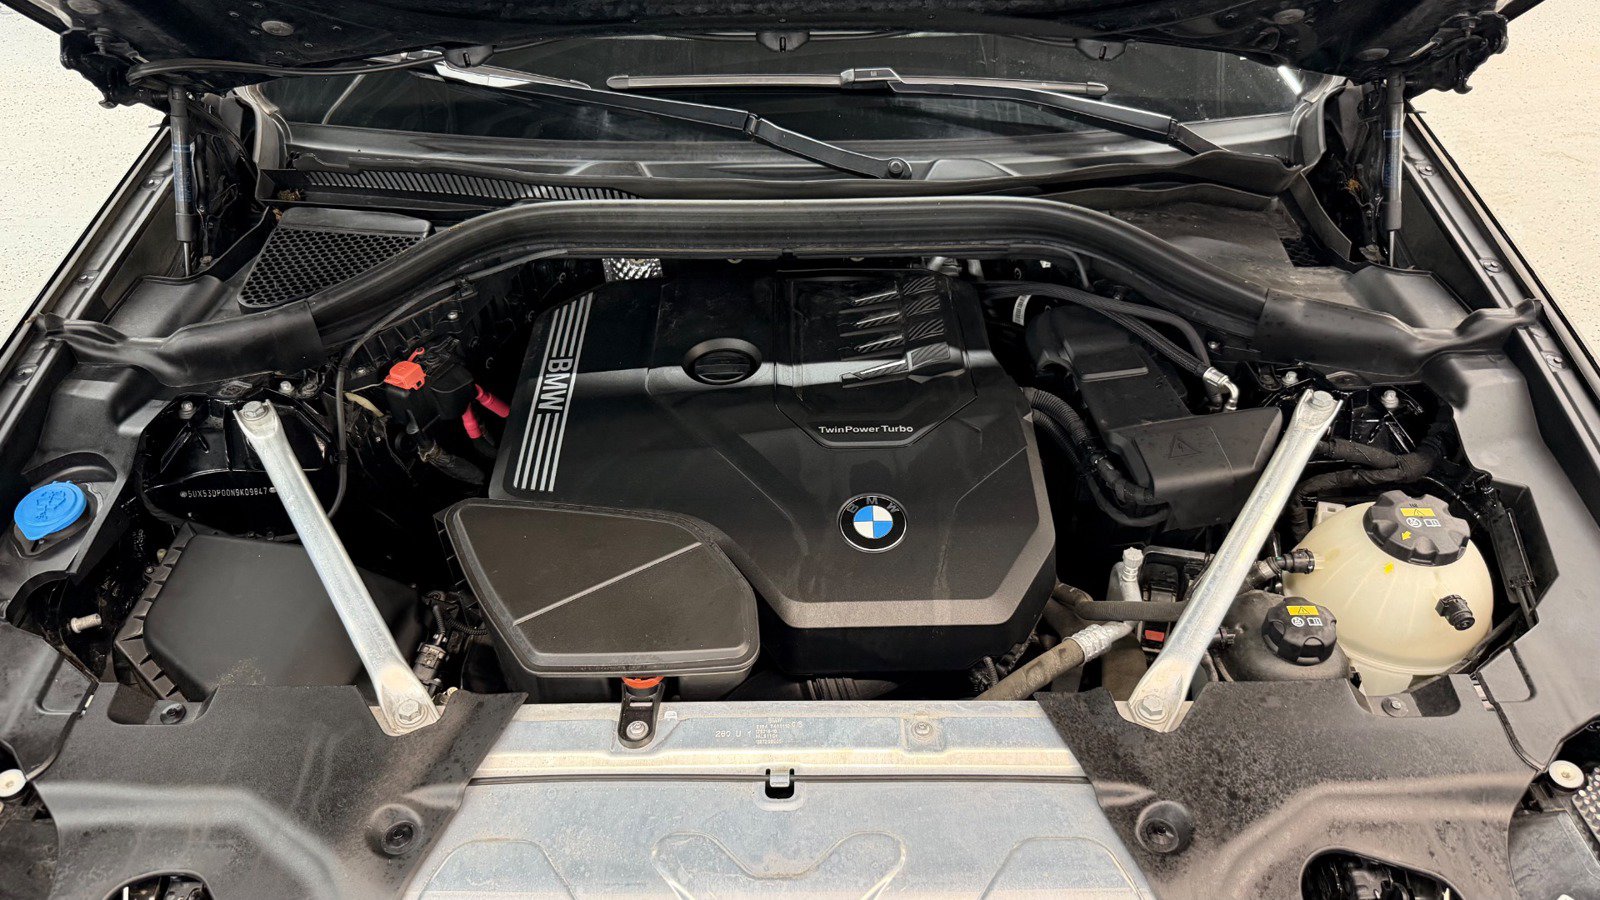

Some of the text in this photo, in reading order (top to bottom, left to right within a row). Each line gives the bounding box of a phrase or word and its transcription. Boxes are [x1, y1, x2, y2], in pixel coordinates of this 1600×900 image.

[537, 358, 574, 411] BMW
[818, 424, 914, 434] TwinPower Turbo
[846, 495, 900, 514] BMW
